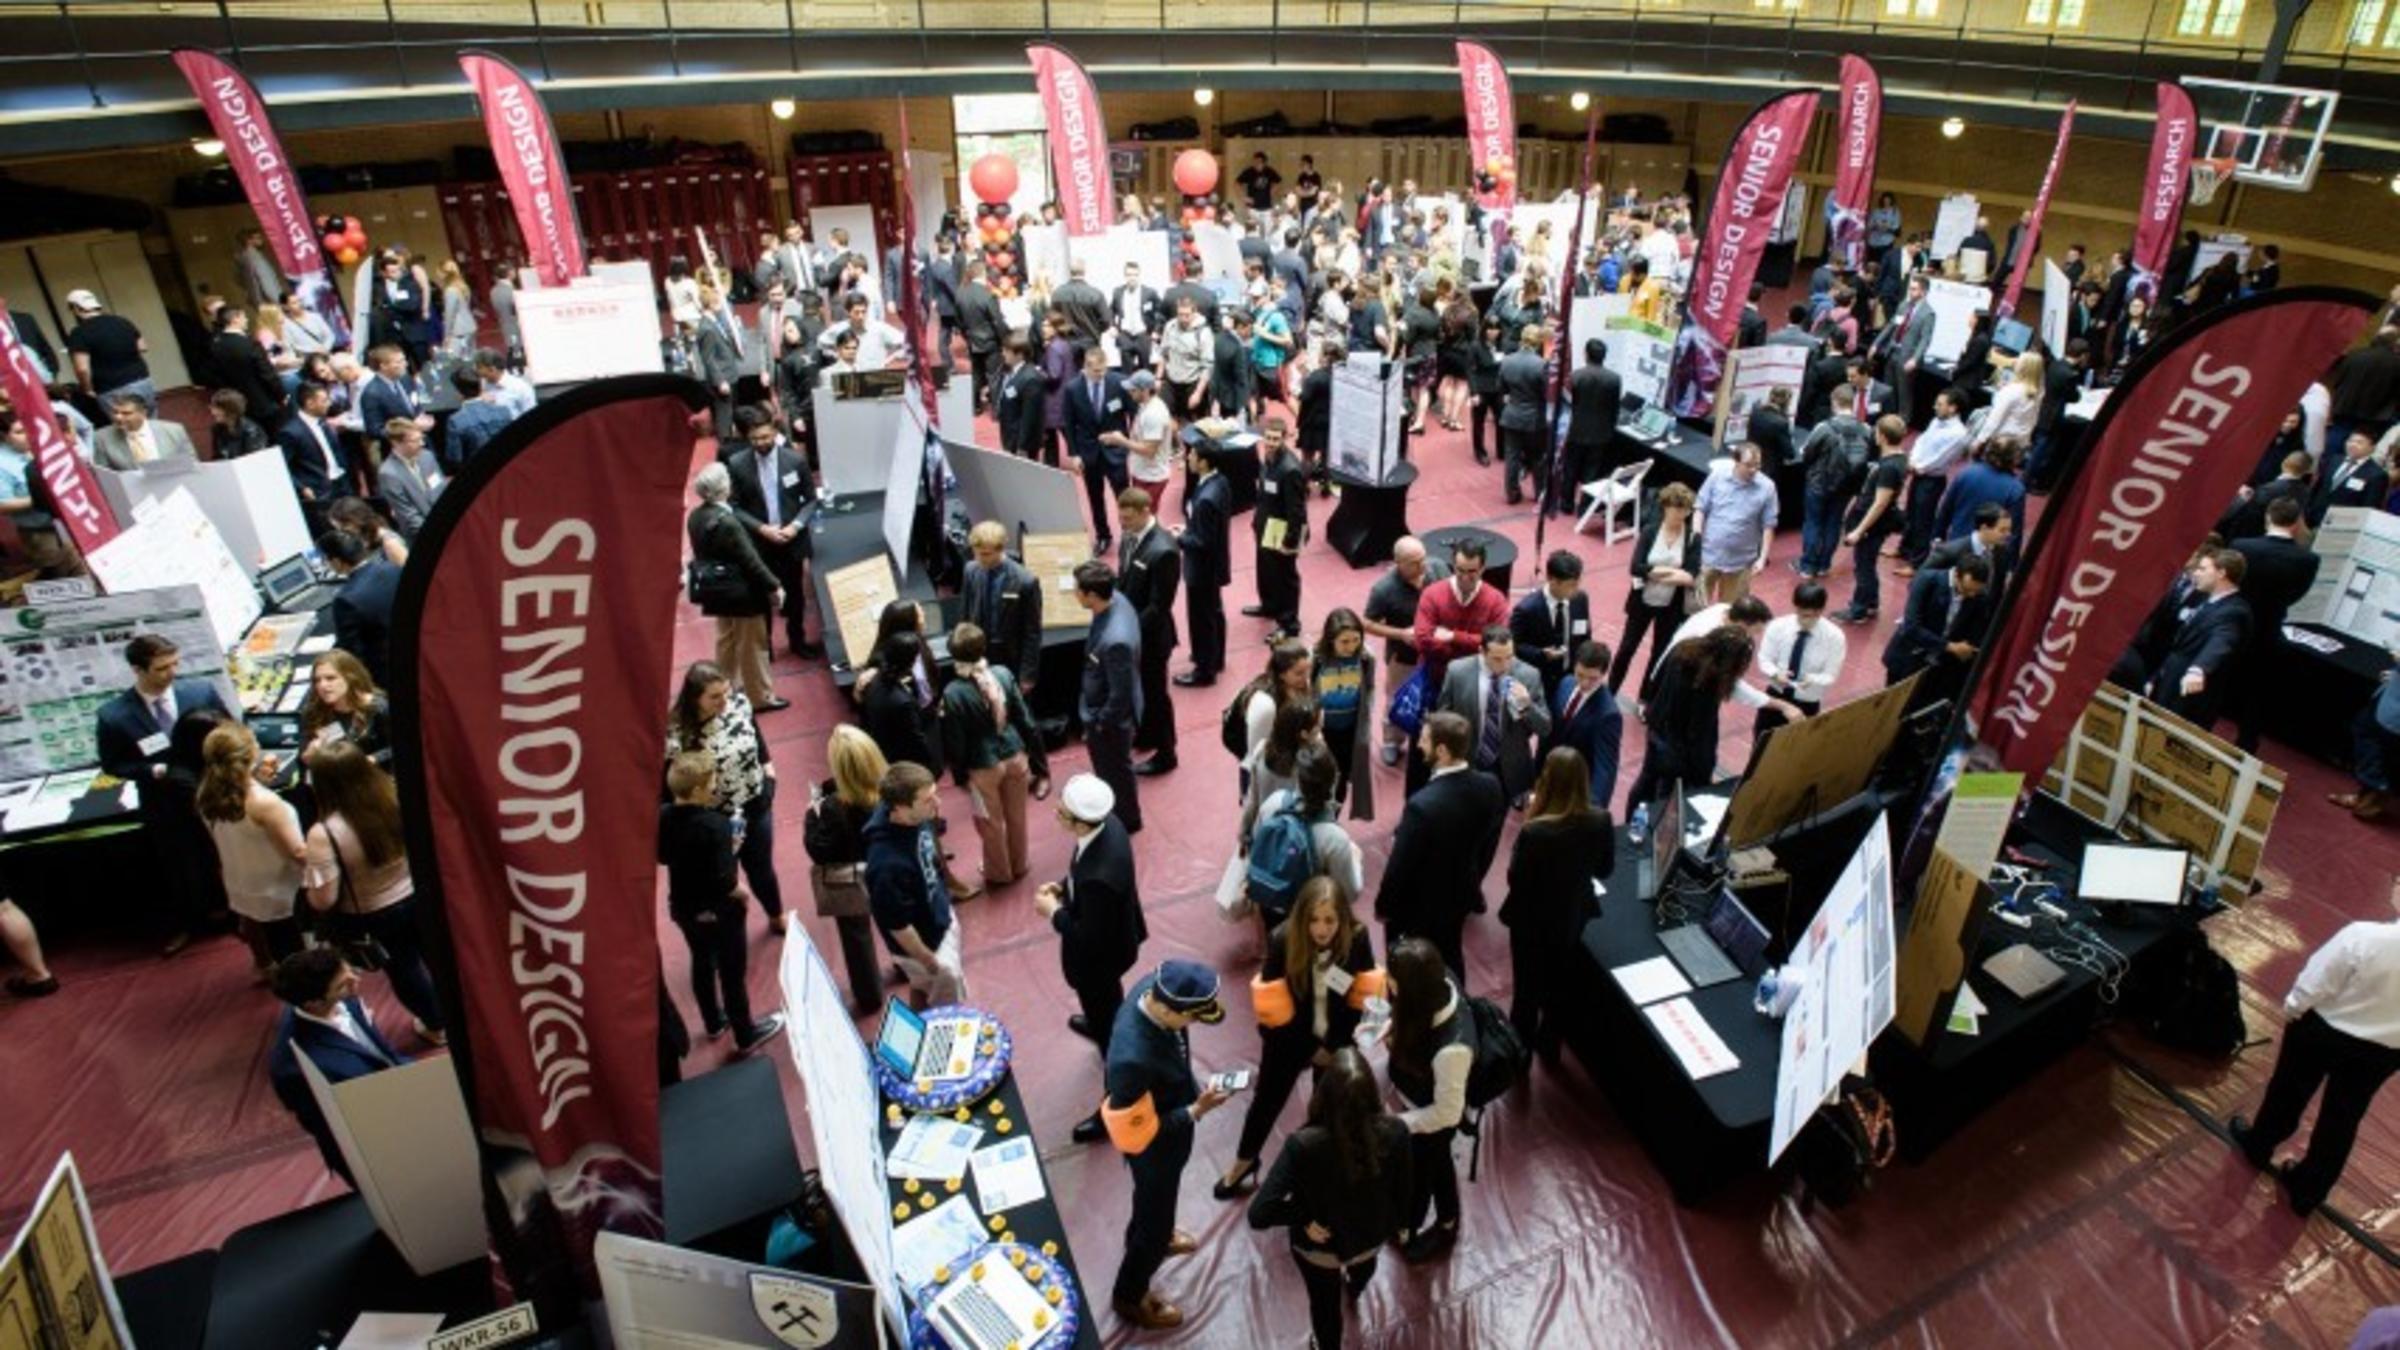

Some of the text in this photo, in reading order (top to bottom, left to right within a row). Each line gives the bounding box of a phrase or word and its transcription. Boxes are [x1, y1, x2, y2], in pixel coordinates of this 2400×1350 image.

[212, 75, 279, 172] DESIGN
[496, 83, 548, 187] DESIGN
[1054, 68, 1101, 233] SENIOR DESIGN
[1475, 63, 1501, 131] DESIGN
[1703, 123, 1783, 320] SENIOR DESIGN
[1993, 352, 2253, 741] SENIOR DESIGN
[498, 517, 597, 1132] SENIOR DESIGN
